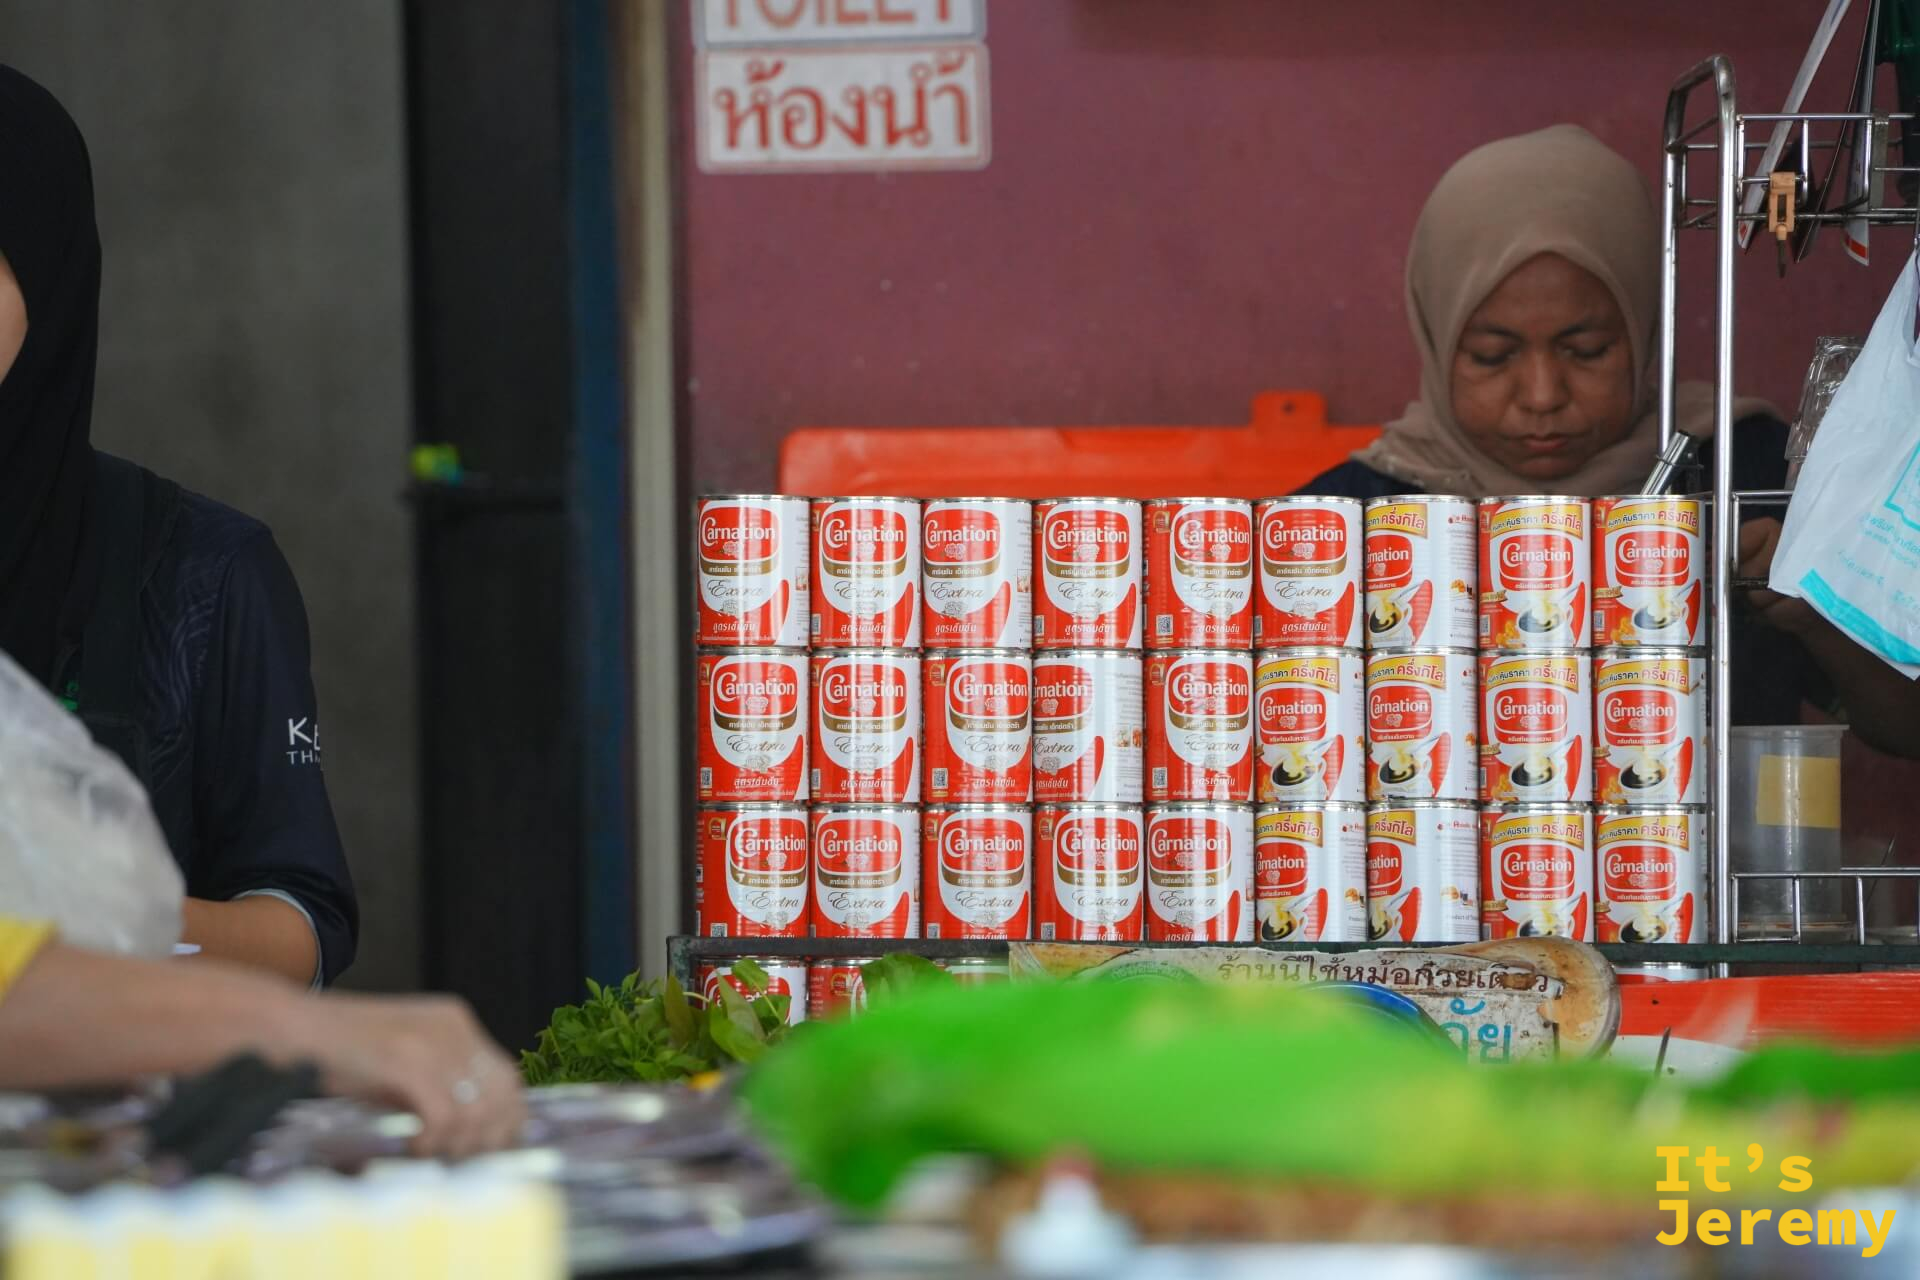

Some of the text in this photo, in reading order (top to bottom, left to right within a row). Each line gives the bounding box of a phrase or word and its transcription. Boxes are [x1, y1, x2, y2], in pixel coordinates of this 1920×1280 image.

[713, 52, 970, 148] ห้องน้ำ
[702, 517, 776, 547] Carnation
[826, 518, 904, 548] Carnation
[925, 519, 996, 548] Carnation
[1049, 519, 1127, 549] Carnation
[1179, 519, 1249, 549] Carnation
[1265, 519, 1343, 549] Carnation
[1503, 543, 1571, 567] Carnation
[1618, 539, 1687, 563] Carnation
[1275, 580, 1334, 599] Extra
[717, 672, 795, 702] Carnation
[826, 673, 904, 703] Carnation
[953, 672, 1028, 702] Carnation
[1173, 672, 1248, 702] Carnation
[1261, 697, 1323, 720] Carnation
[1370, 695, 1428, 718] Carnation
[1497, 695, 1564, 720] Carnation
[1607, 698, 1673, 722] Carnation
[735, 828, 806, 858] Carnation
[820, 829, 898, 858] Carnation
[944, 828, 1022, 858] Carnation
[1060, 827, 1137, 857] Carnation
[1151, 828, 1227, 858] Carnation
[1503, 852, 1572, 876] Carnation
[1606, 854, 1673, 878] Carnation
